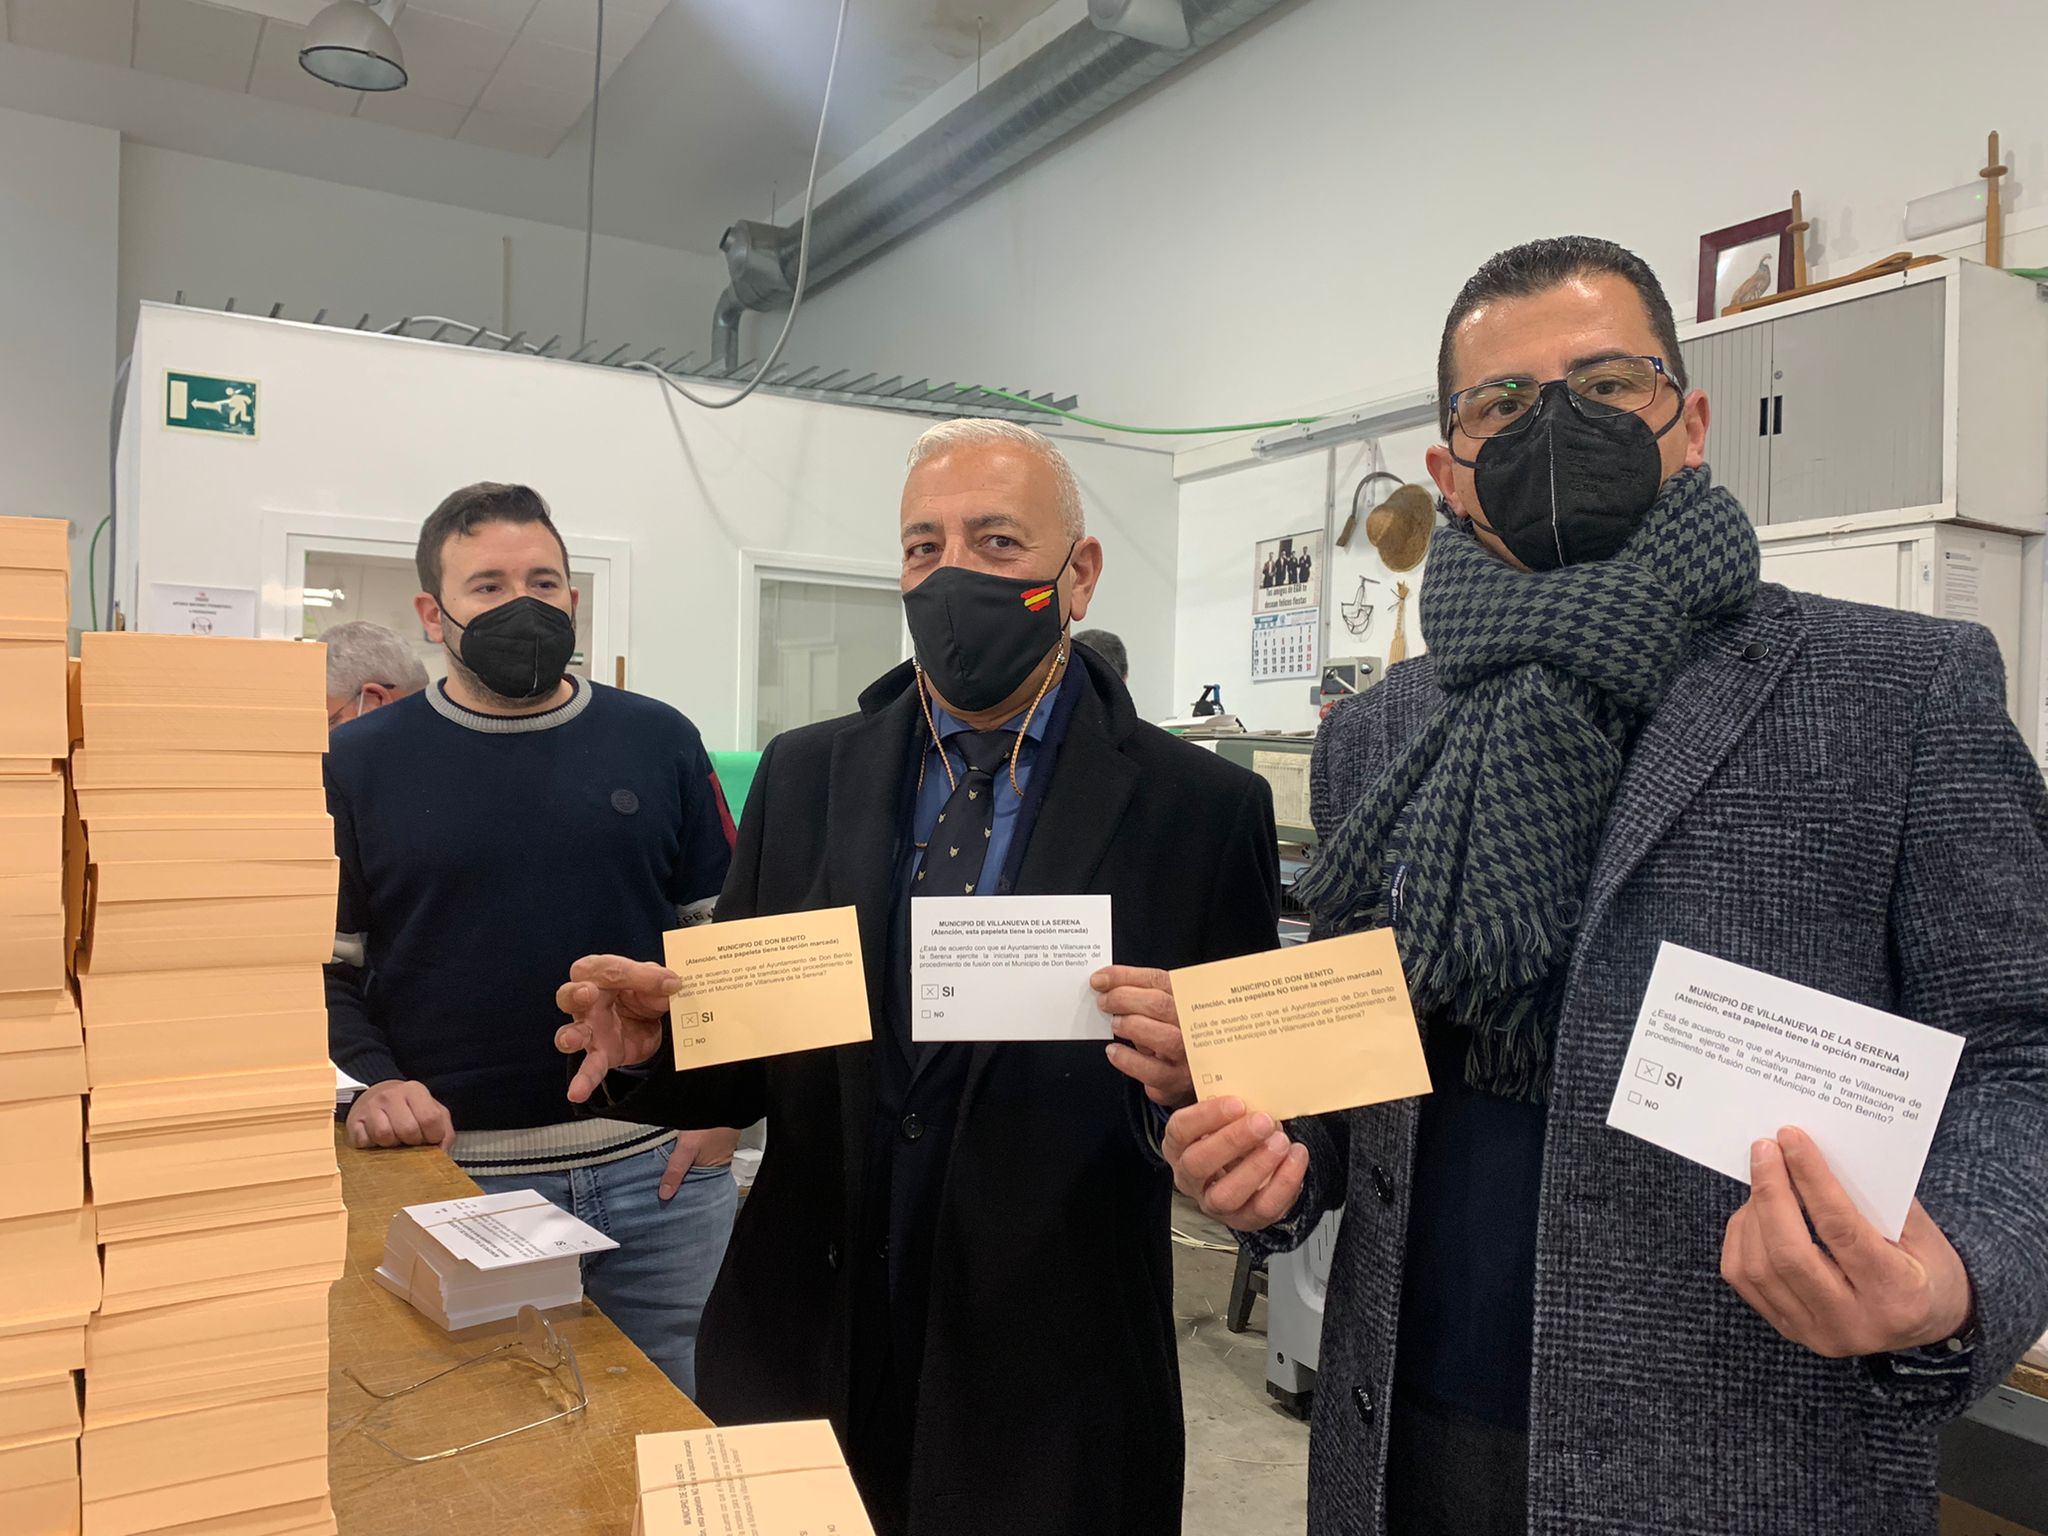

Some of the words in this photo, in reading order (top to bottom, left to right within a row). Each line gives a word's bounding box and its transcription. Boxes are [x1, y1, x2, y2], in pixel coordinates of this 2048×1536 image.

[1033, 927, 1056, 935] opción
[717, 941, 752, 952] MUNICIPIO
[780, 934, 806, 943] BENITO
[734, 949, 761, 958] papeleta
[786, 942, 808, 950] opción
[809, 938, 839, 946] marcada)
[1007, 944, 1049, 952] Ayuntamiento
[919, 961, 962, 969] procedimiento
[1227, 996, 1243, 1004] esta
[1243, 990, 1275, 1002] papeleta
[1276, 986, 1289, 995] NO
[1289, 983, 1309, 992] tiene
[1318, 976, 1345, 987] opción
[1346, 967, 1383, 981] marcada)
[1230, 980, 1271, 994] MUNICIPIO
[1271, 977, 1283, 986] DE
[1284, 974, 1302, 984] DON
[1303, 967, 1334, 980] BENITO
[942, 986, 954, 997] SI
[1209, 1019, 1219, 1027] de
[1220, 1014, 1248, 1025] acuerdo
[1250, 1011, 1264, 1020] con
[1265, 1008, 1279, 1017] que
[1281, 1005, 1289, 1014] el
[1290, 997, 1339, 1012] Ayuntamiento
[1340, 994, 1351, 1002] de
[1352, 990, 1369, 999] Don
[1370, 985, 1395, 995] Benito
[701, 1011, 714, 1023] SI
[1688, 984, 1739, 1008] MUNICIPIO
[1740, 1002, 1754, 1013] DE
[1756, 1007, 1818, 1035] VILLANUEVA
[1820, 1029, 1836, 1041] DE
[1837, 1035, 1851, 1047] LA
[1854, 1041, 1899, 1063] SERENA
[1192, 1040, 1212, 1048] fusión
[1212, 1037, 1226, 1045] con
[1233, 1030, 1267, 1041] Municipio
[1278, 1020, 1315, 1033] Villanueva
[1315, 1018, 1326, 1026] de
[1674, 992, 1719, 1015] (Atención,
[1721, 1009, 1742, 1021] esta
[1742, 1016, 1783, 1035] papeleta
[1784, 1030, 1809, 1044] tiene
[1810, 1038, 1820, 1048] la
[1821, 1044, 1857, 1061] opción
[1859, 1057, 1909, 1080] marcada)
[1648, 1017, 1656, 1027] la
[1662, 1022, 1693, 1040] Serena
[1698, 1037, 1730, 1053] ejercite
[1736, 1048, 1744, 1058] la
[1750, 1054, 1788, 1075] iniciativa
[1794, 1072, 1816, 1085] para
[1823, 1080, 1832, 1090] la
[1839, 1086, 1894, 1112] tramitación
[1901, 1109, 1919, 1120] del
[1651, 1008, 1677, 1022] ¿Está
[1678, 1017, 1689, 1027] de
[1690, 1022, 1726, 1039] acuerdo
[1727, 1035, 1744, 1046] con
[1745, 1041, 1763, 1053] que
[1764, 1048, 1774, 1056] el
[1773, 1050, 1837, 1079] Ayuntamiento
[1838, 1074, 1852, 1085] de
[1855, 1078, 1906, 1104] Villanueva
[1908, 1098, 1922, 1109] de
[1214, 1074, 1223, 1082] SI
[1644, 1029, 1703, 1055] procedimiento
[1704, 1050, 1716, 1060] de
[1717, 1053, 1743, 1070] fusión
[1744, 1065, 1761, 1077] con
[1762, 1072, 1772, 1080] el
[1772, 1074, 1816, 1097] Municipio
[1817, 1092, 1830, 1102] de
[1832, 1095, 1853, 1110] Don
[1854, 1104, 1894, 1124] Benito?
[1664, 1072, 1683, 1090] SI
[1644, 1099, 1659, 1110] NO
